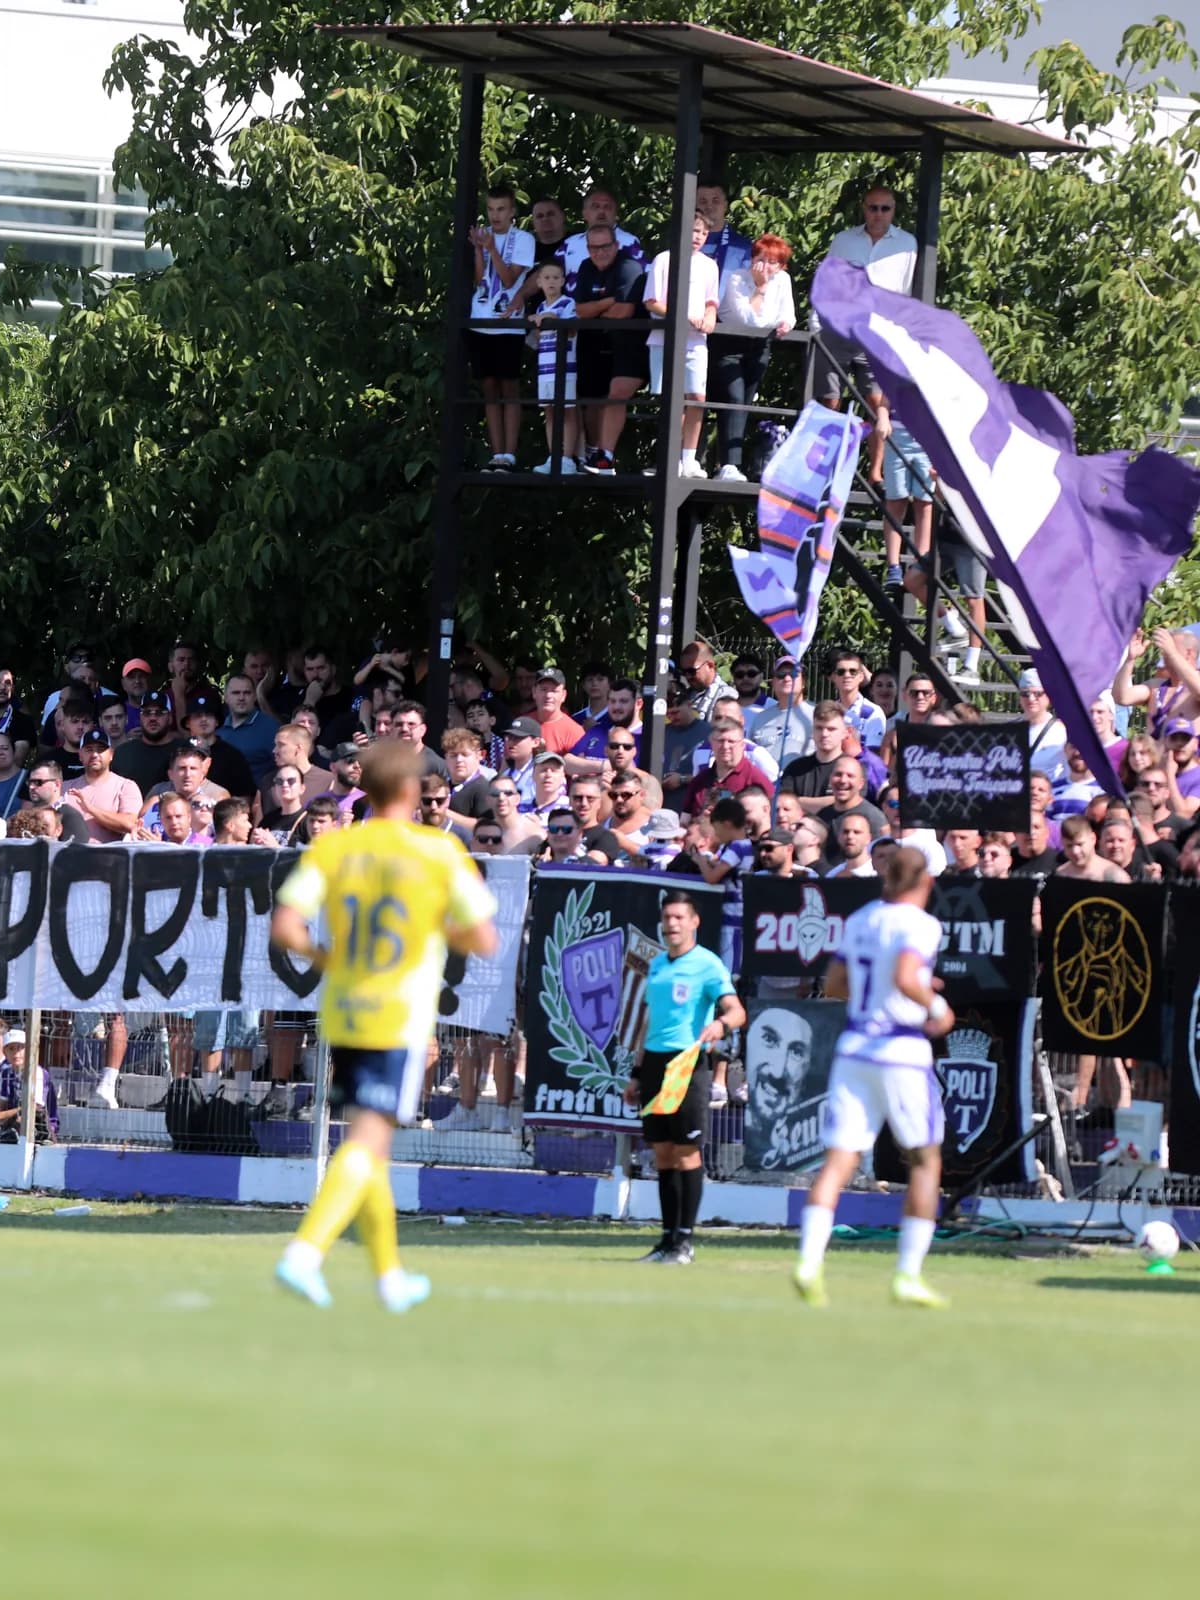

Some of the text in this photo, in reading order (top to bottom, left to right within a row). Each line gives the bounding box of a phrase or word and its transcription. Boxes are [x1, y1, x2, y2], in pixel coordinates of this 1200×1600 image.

[344, 894, 408, 974] 16
[571, 911, 611, 938] 1921
[572, 947, 617, 988] POLI
[857, 957, 873, 1012] 7
[581, 986, 615, 1031] T
[948, 1069, 986, 1100] POLI
[953, 1104, 978, 1134] T
